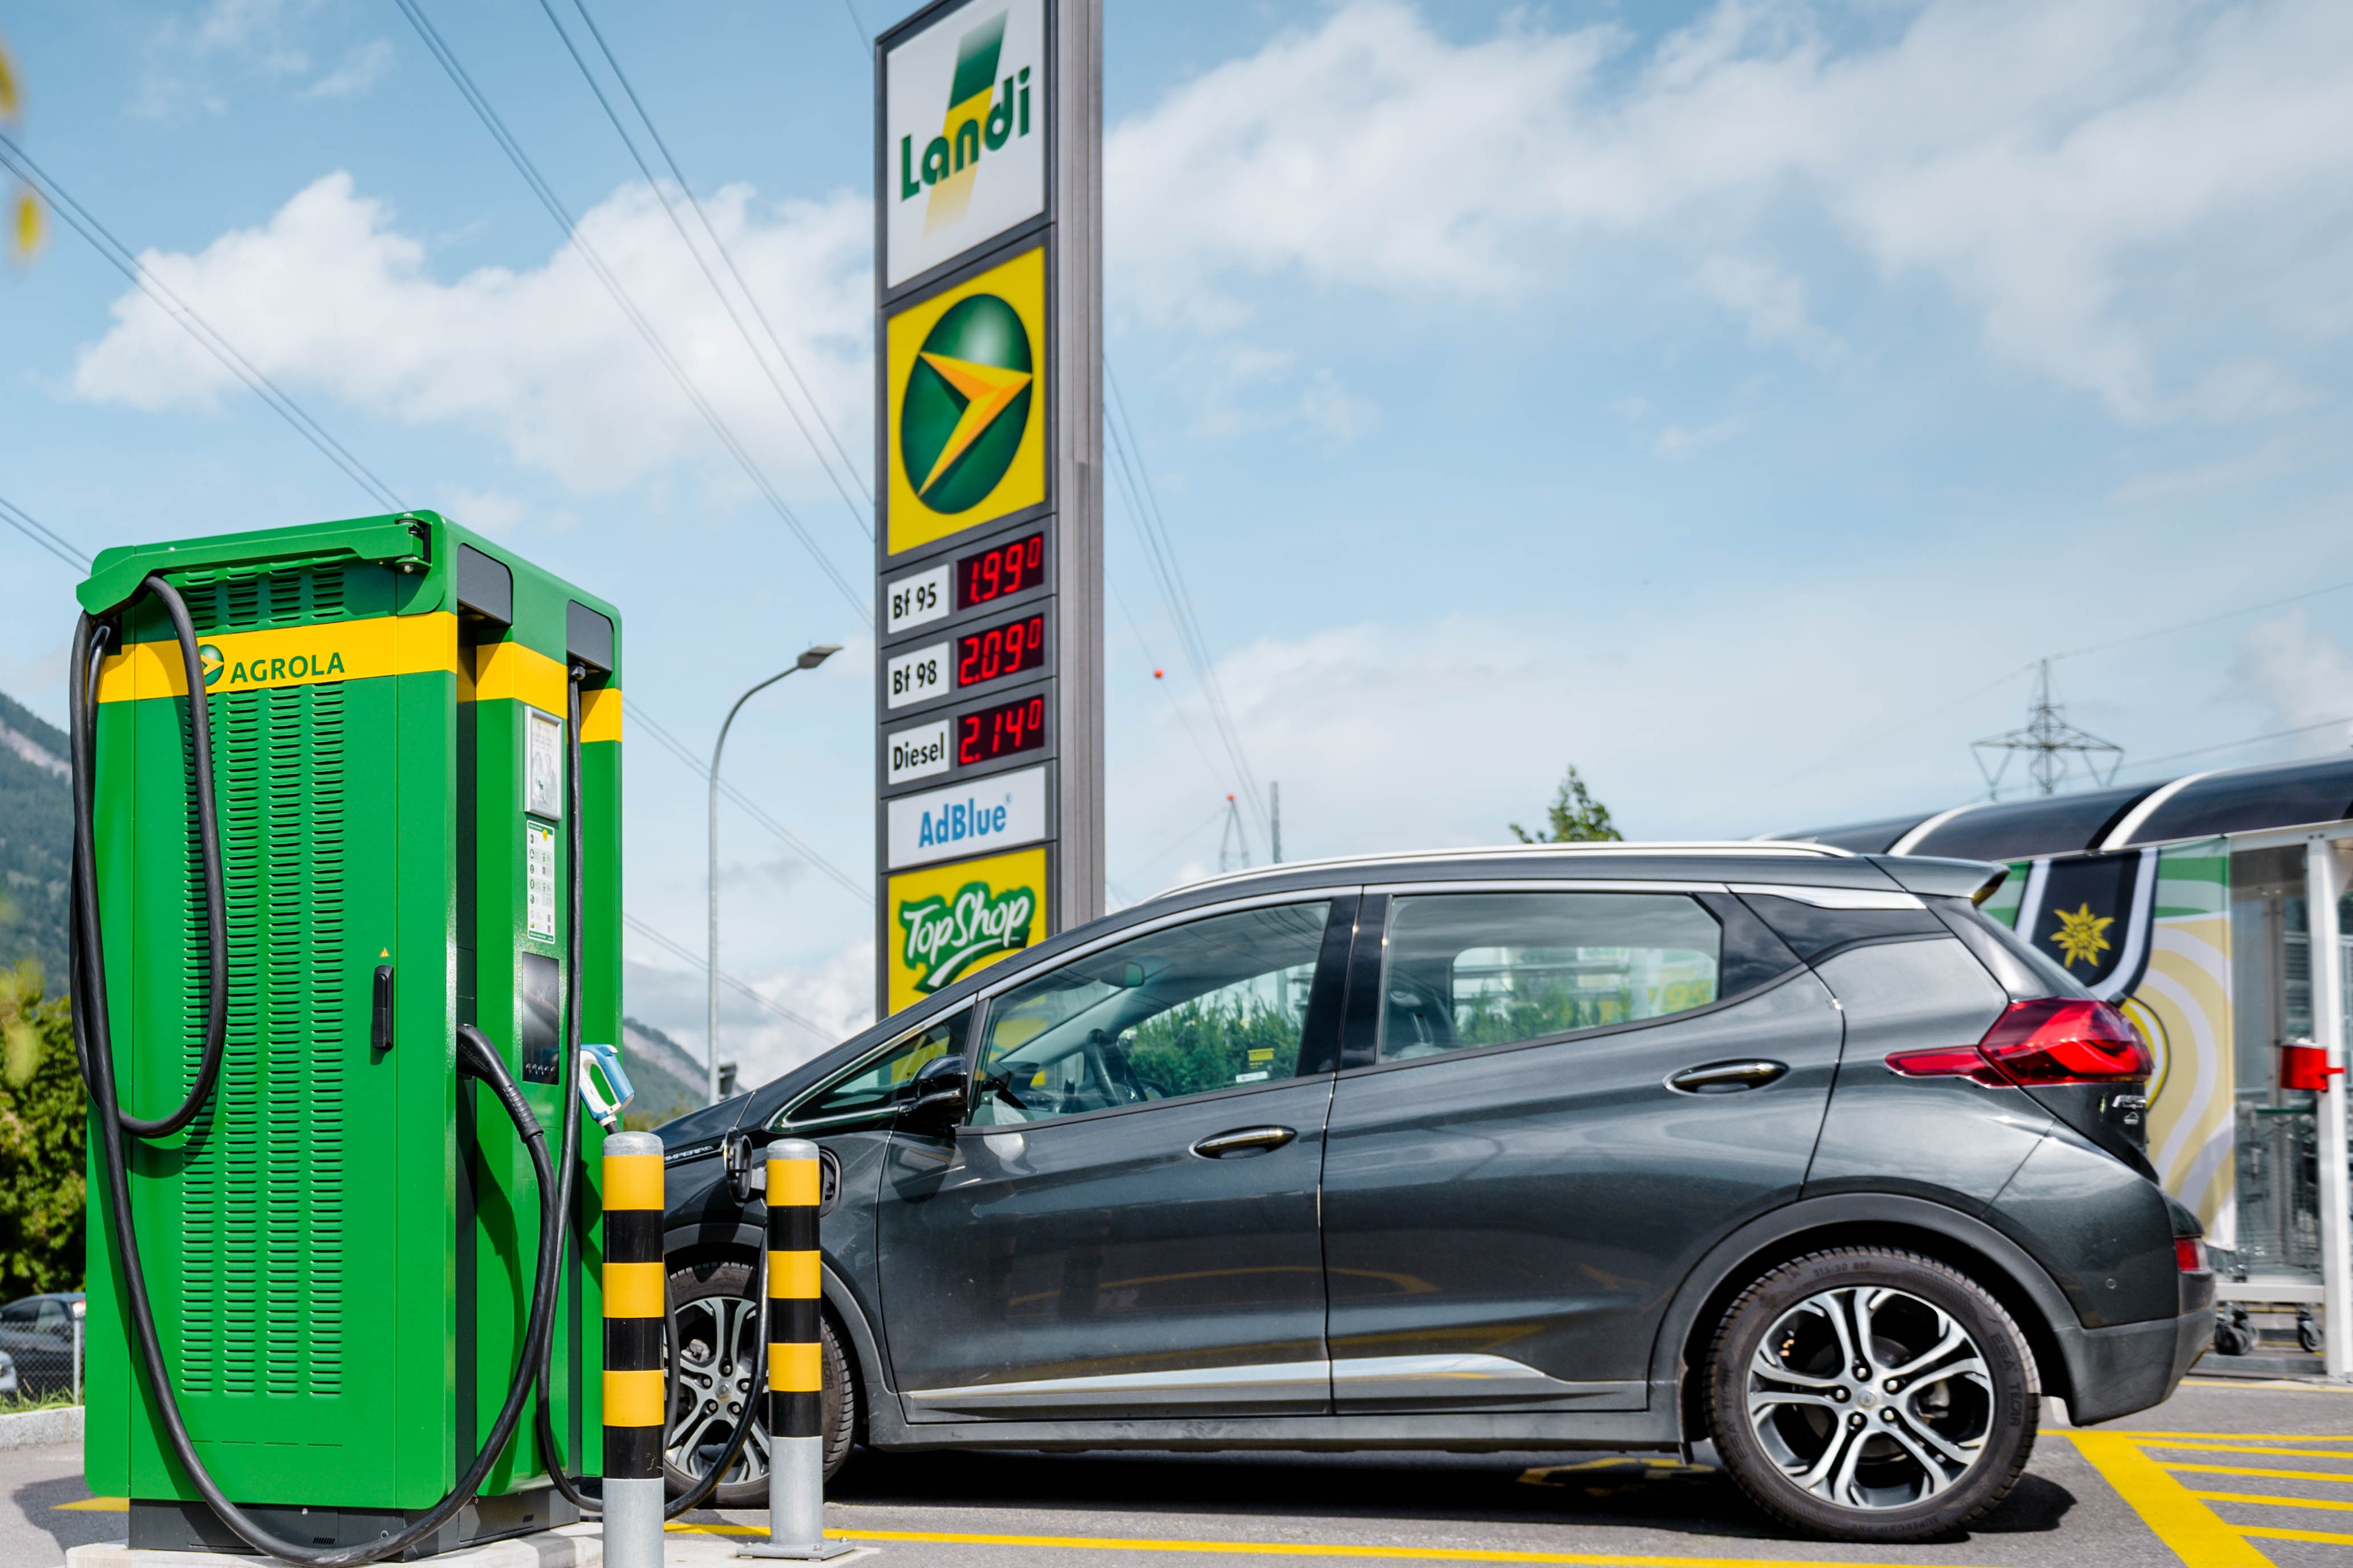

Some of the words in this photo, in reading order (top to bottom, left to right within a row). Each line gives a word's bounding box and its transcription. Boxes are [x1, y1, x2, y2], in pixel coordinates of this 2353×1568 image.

[901, 66, 1030, 201] Landi
[894, 590, 910, 620] Bf
[917, 582, 937, 611] 95
[230, 652, 345, 684] AGROLA
[894, 665, 910, 696] Bf
[917, 659, 937, 688] 98
[893, 732, 945, 771] Diesel
